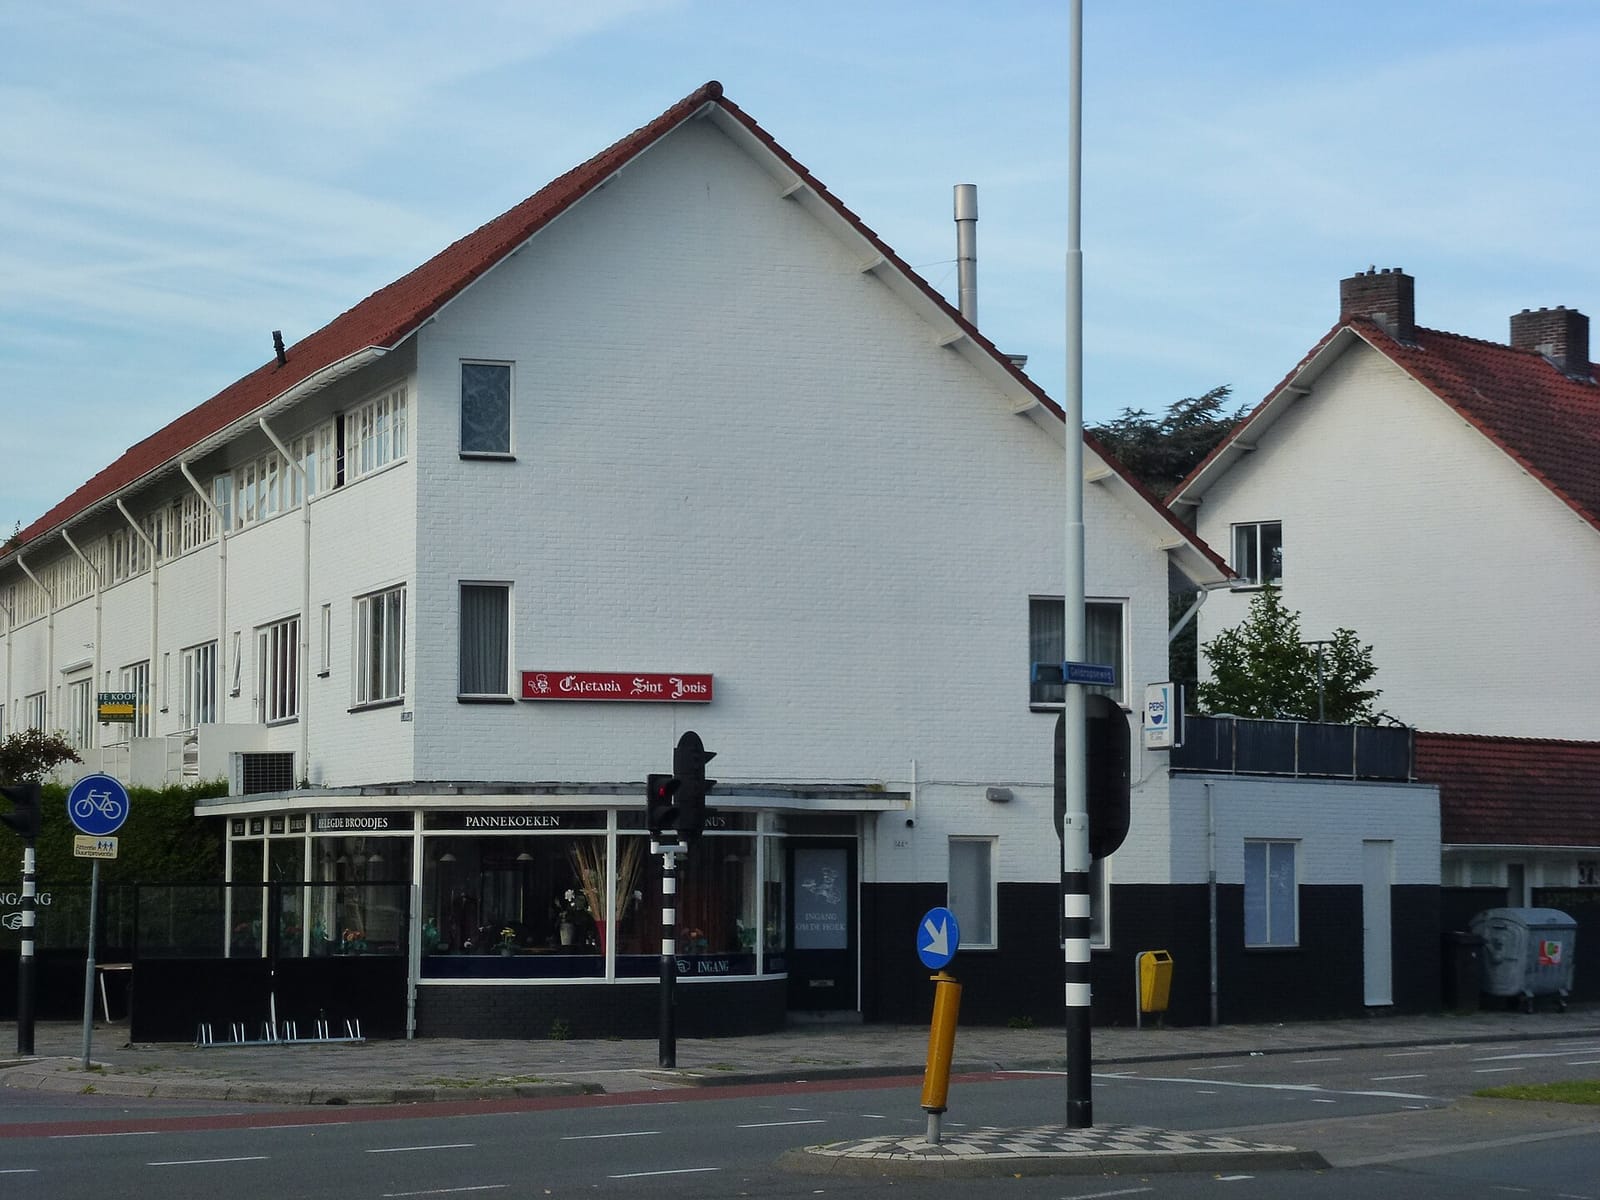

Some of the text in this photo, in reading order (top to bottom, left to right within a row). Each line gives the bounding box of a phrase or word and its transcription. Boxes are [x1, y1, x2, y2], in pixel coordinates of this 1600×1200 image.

[560, 675, 707, 699] Cafetaria Sint Joris
[345, 817, 388, 830] BROODJES
[465, 816, 560, 827] PANNEKOEKEN
[697, 960, 729, 973] INGANG
